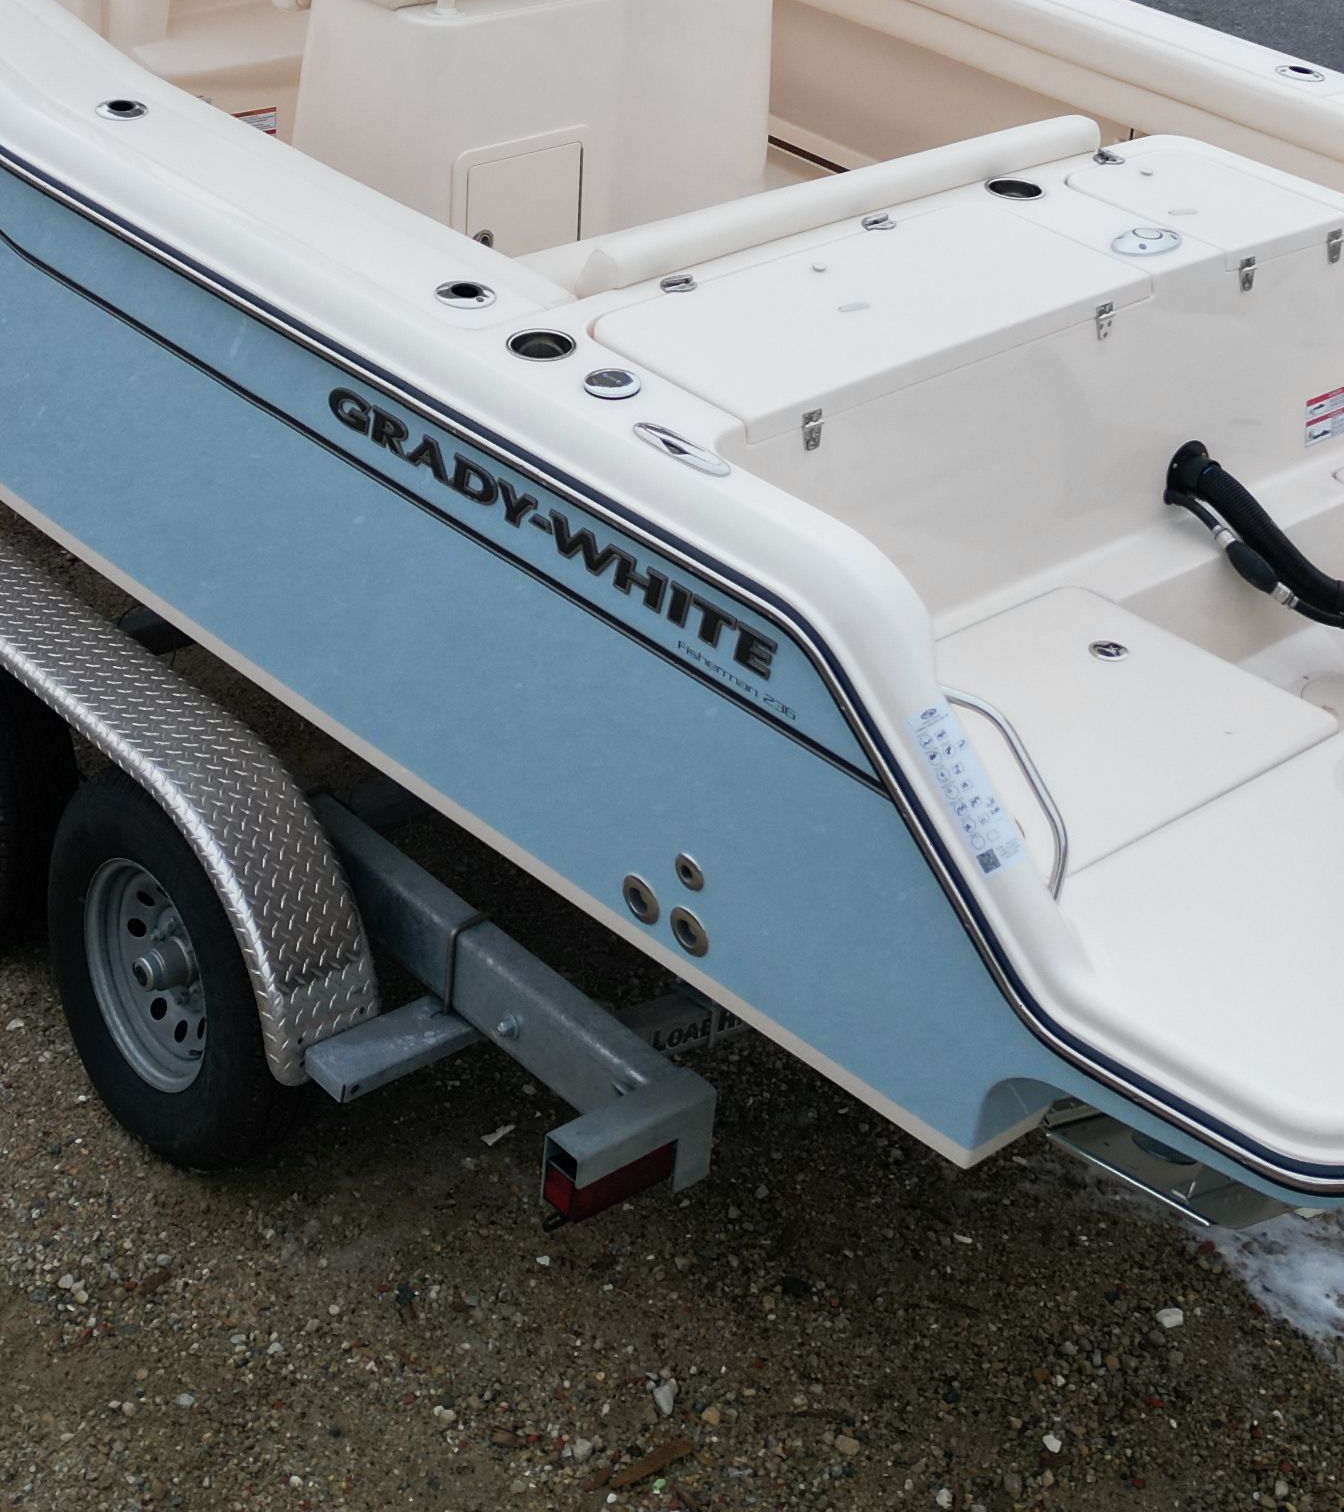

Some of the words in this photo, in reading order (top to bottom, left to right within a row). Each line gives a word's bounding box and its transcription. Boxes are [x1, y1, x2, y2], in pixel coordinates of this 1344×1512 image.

[328, 387, 778, 681] GRADY-WHITE
[677, 640, 758, 697] Fisherman
[763, 693, 796, 720] 236
